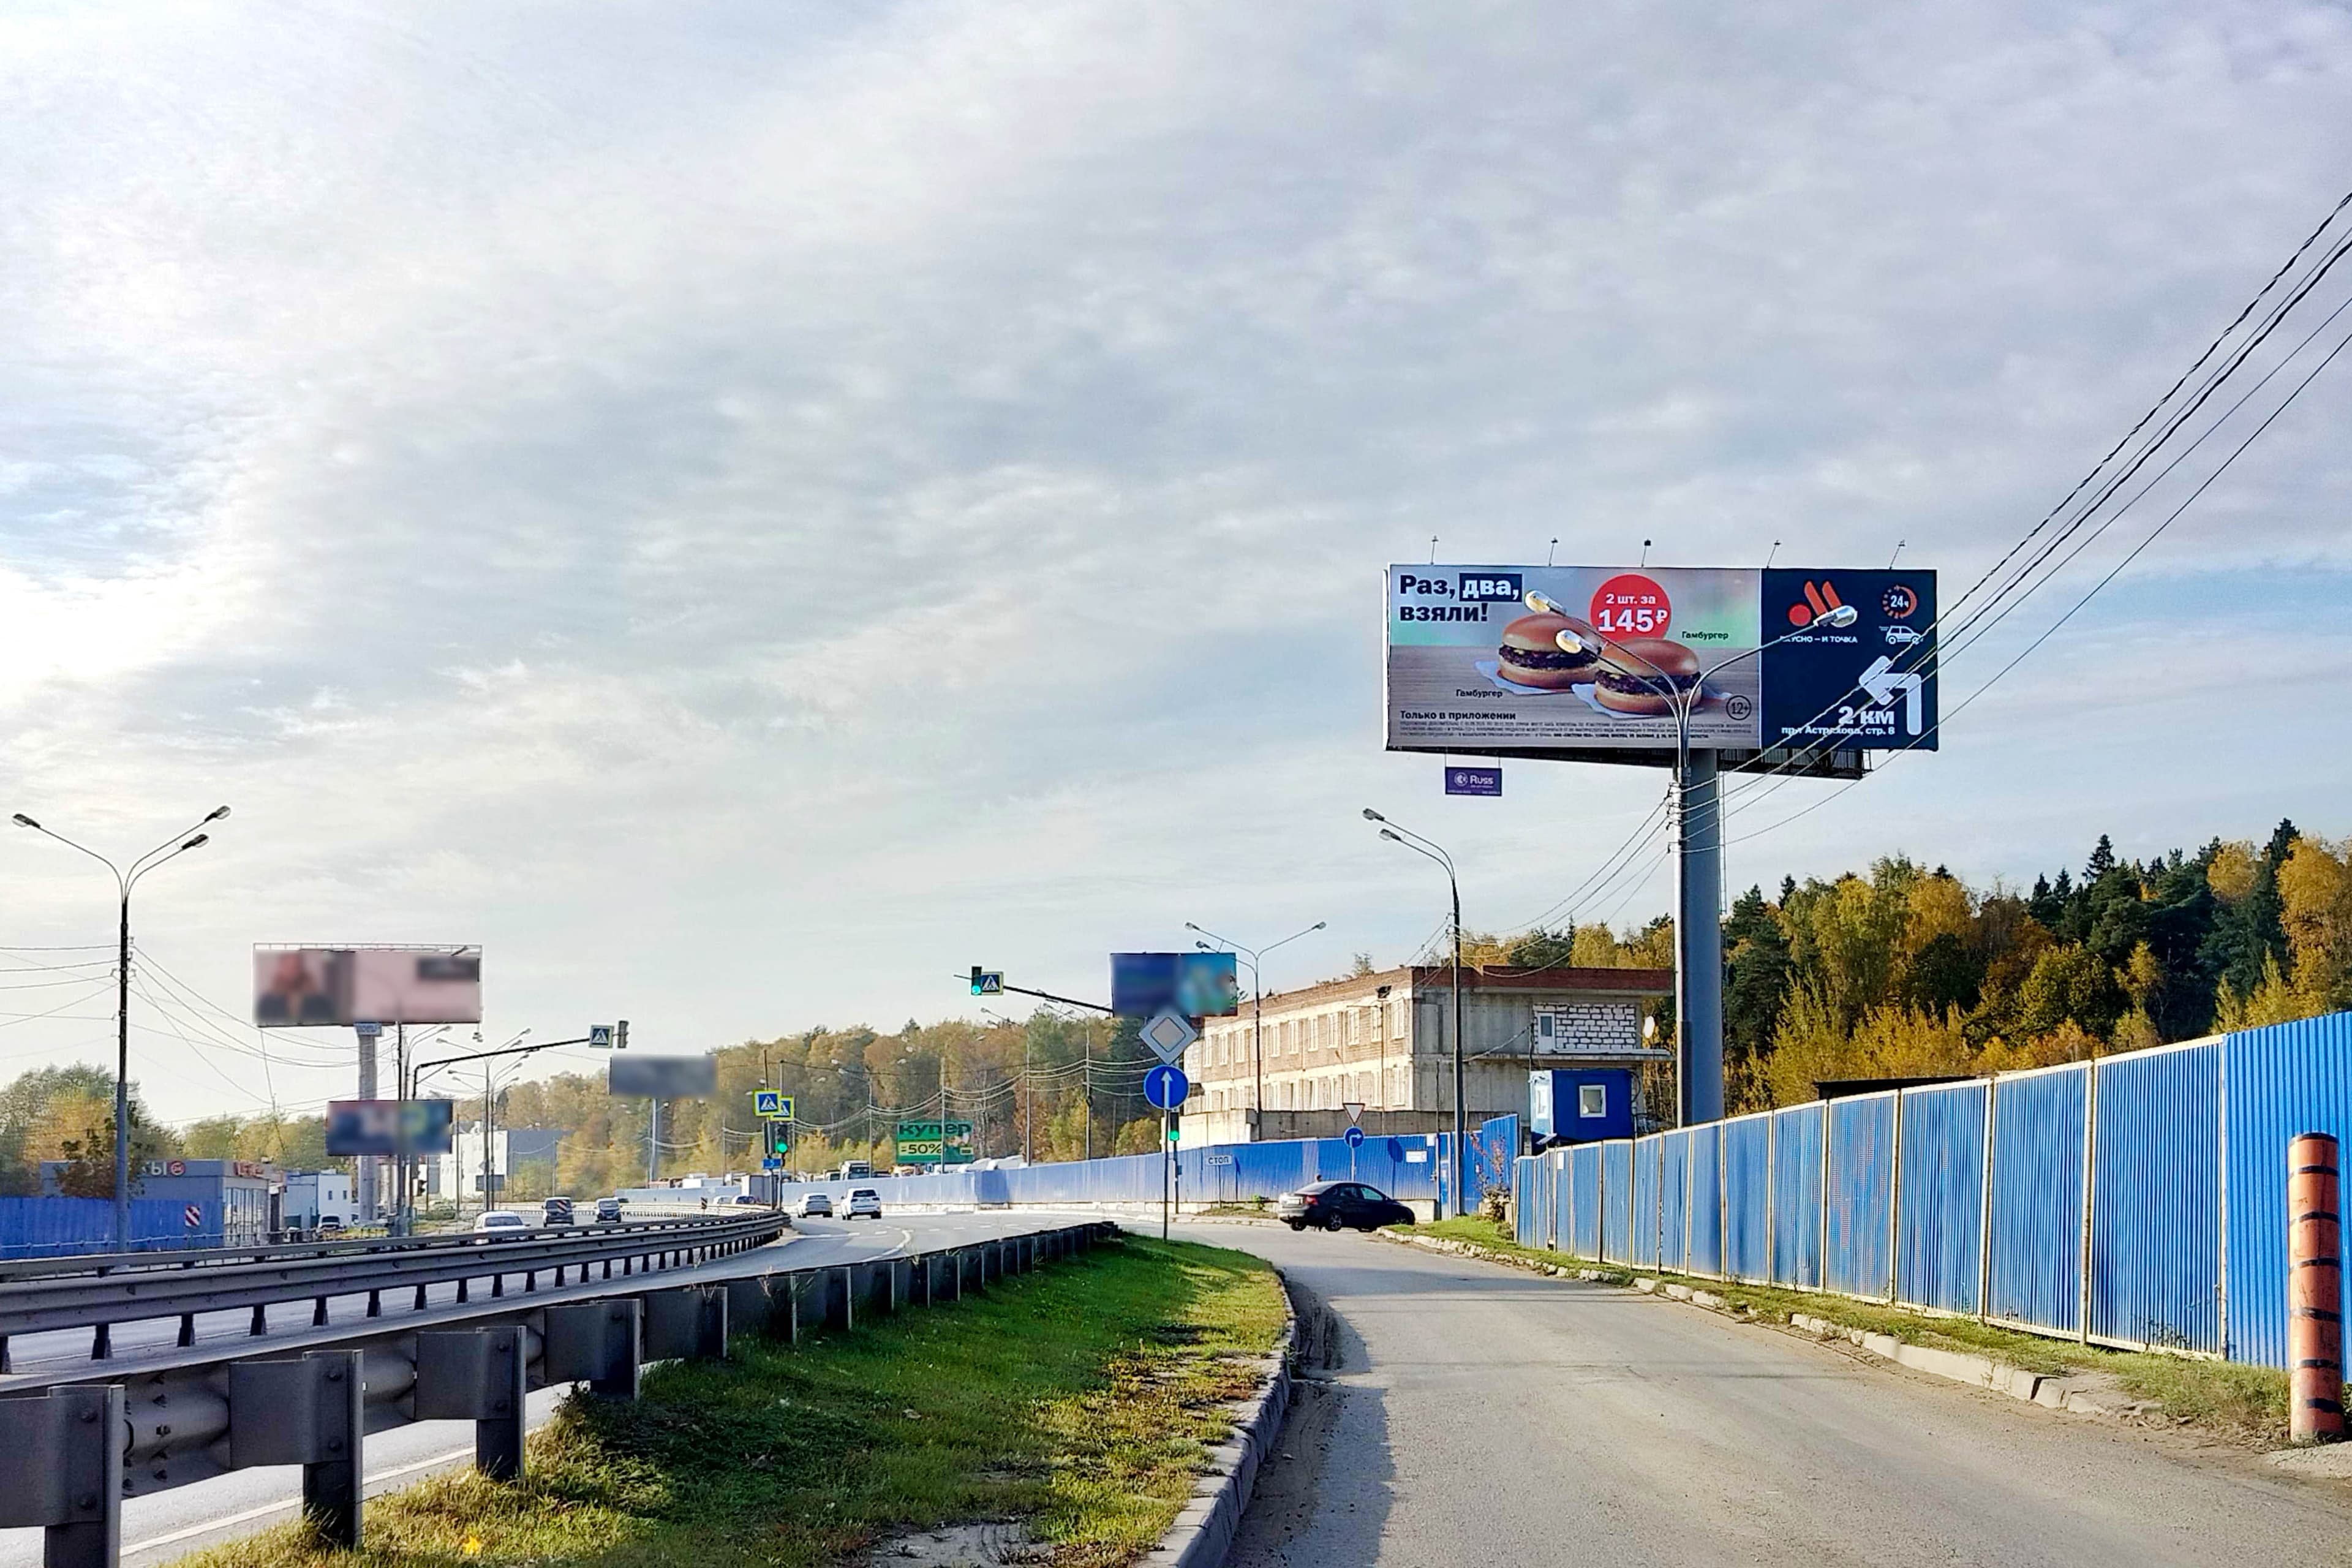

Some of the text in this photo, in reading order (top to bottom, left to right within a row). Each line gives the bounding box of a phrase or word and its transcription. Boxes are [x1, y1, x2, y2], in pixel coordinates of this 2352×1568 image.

[1400, 575, 1519, 600] Раз, два,
[1606, 594, 1615, 604] 2
[1640, 595, 1656, 604] за
[1400, 603, 1488, 622] взяли!
[1732, 702, 1749, 714] 12+
[1401, 710, 1437, 720] Только
[1838, 706, 1854, 725] 2
[1865, 727, 1886, 736] стр.
[1208, 1156, 1229, 1164] СТОП
